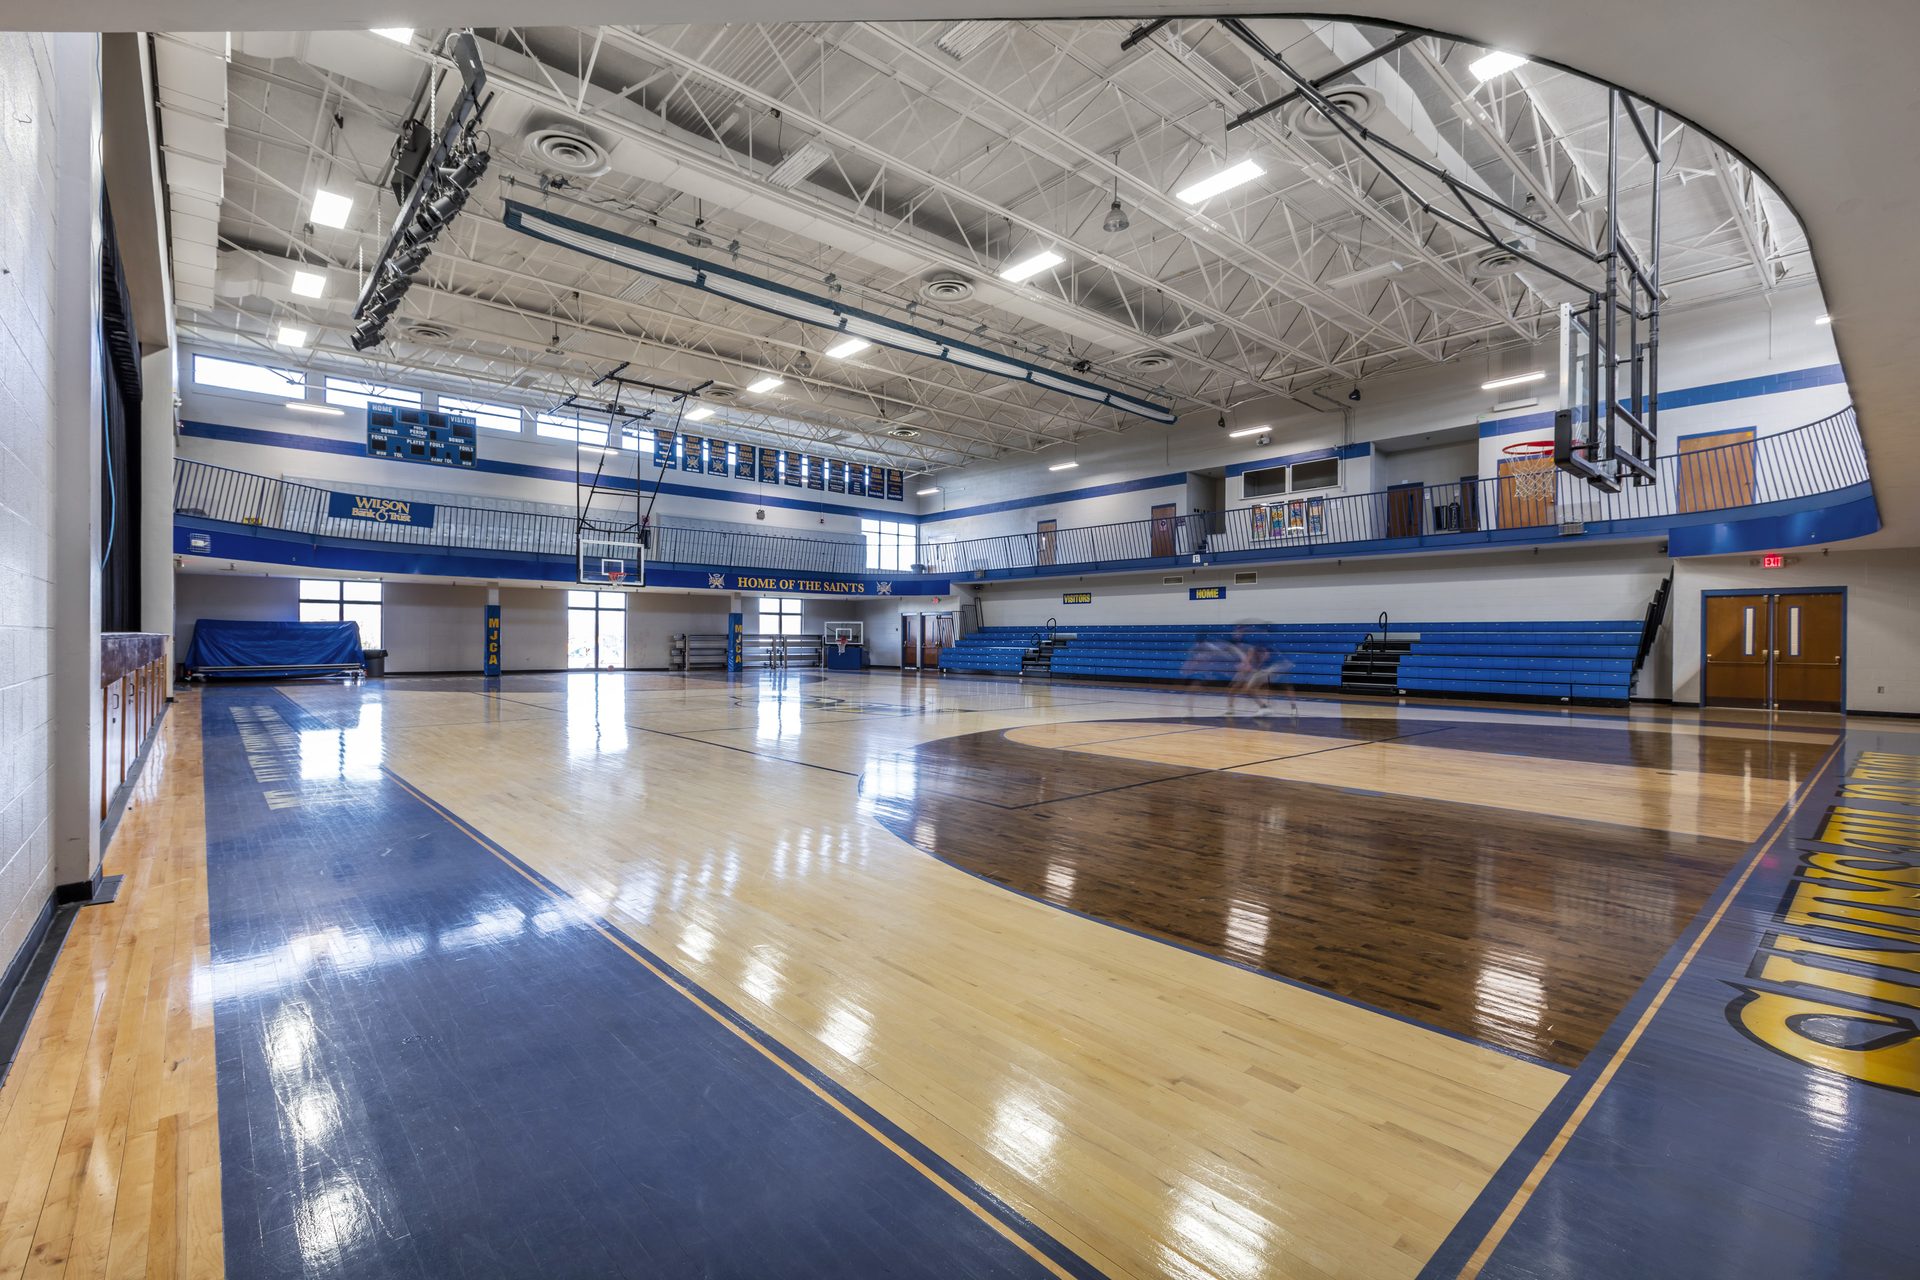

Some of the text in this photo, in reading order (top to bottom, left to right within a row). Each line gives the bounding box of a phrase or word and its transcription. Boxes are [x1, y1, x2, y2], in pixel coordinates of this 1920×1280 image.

[372, 404, 392, 412] HOME
[450, 416, 474, 424] VISITOR
[355, 496, 410, 514] WILSON
[352, 507, 375, 518] Bank
[388, 512, 412, 522] Trust
[1764, 557, 1782, 567] EXIT
[737, 577, 865, 593] HOME OF THE SAINTS
[1063, 594, 1091, 604] VISITORS
[1196, 588, 1219, 599] HOME
[488, 618, 499, 665] MJCA
[734, 624, 743, 664] MJCA
